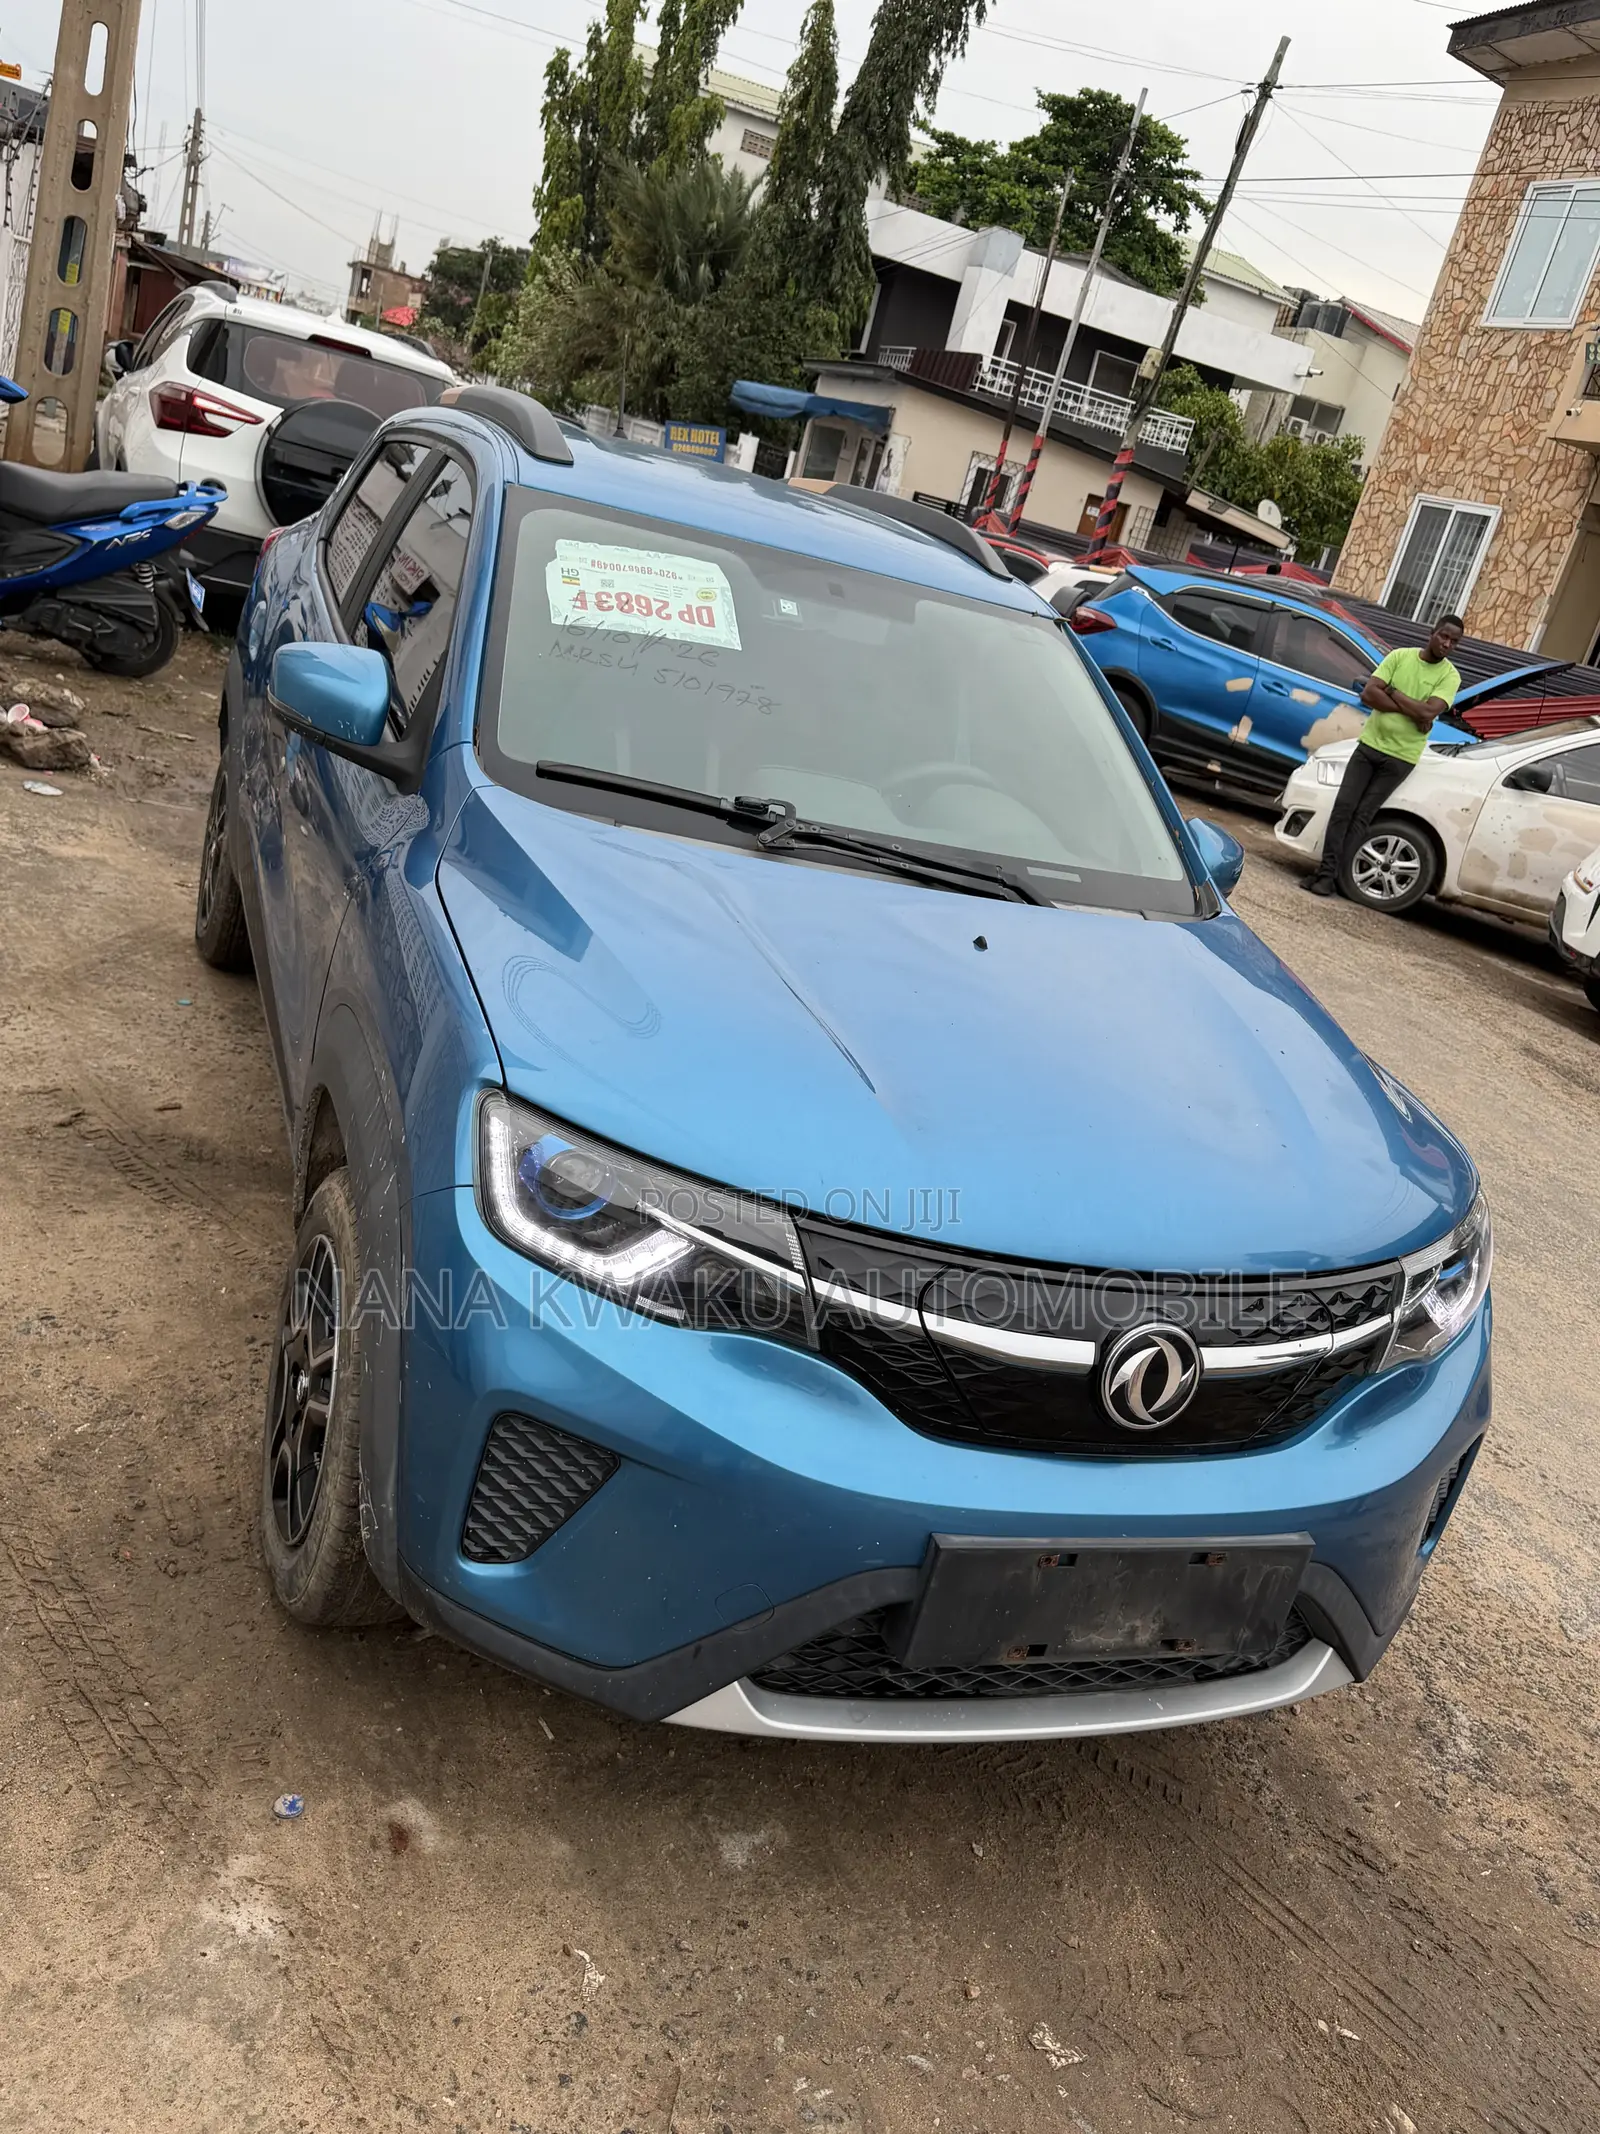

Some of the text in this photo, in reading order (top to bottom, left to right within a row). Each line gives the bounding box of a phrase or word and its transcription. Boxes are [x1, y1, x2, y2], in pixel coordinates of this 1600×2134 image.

[669, 426, 720, 446] REX HOTEL
[561, 567, 579, 577] GH
[594, 591, 673, 621] 2683
[678, 604, 716, 628] DP
